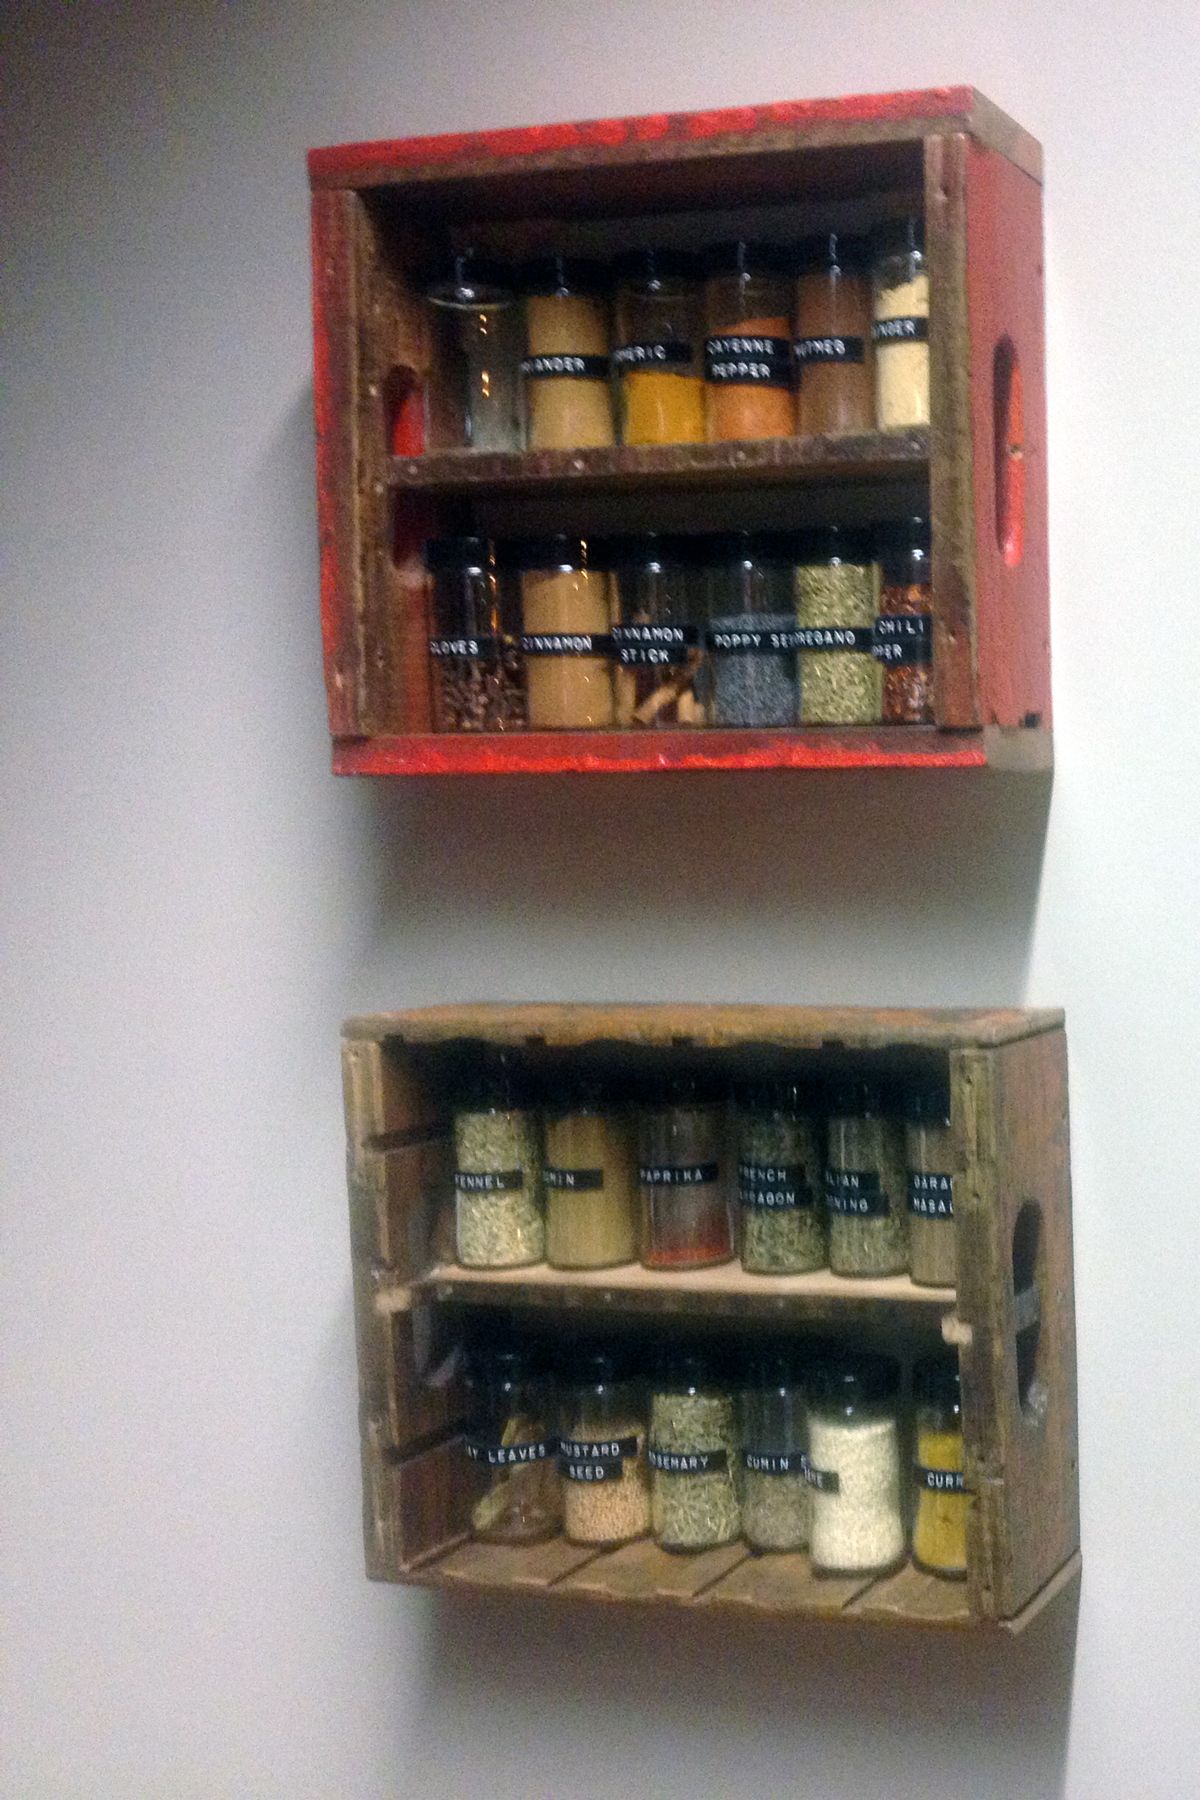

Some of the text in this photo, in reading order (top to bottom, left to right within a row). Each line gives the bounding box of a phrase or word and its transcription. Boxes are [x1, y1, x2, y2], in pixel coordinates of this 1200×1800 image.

[711, 362, 771, 379] PEPPER
[714, 633, 761, 649] POPPY
[620, 648, 671, 664] STICK
[488, 1443, 546, 1465] LEAVES
[746, 1453, 790, 1471] CUMIN
[569, 1464, 605, 1480] SEED
